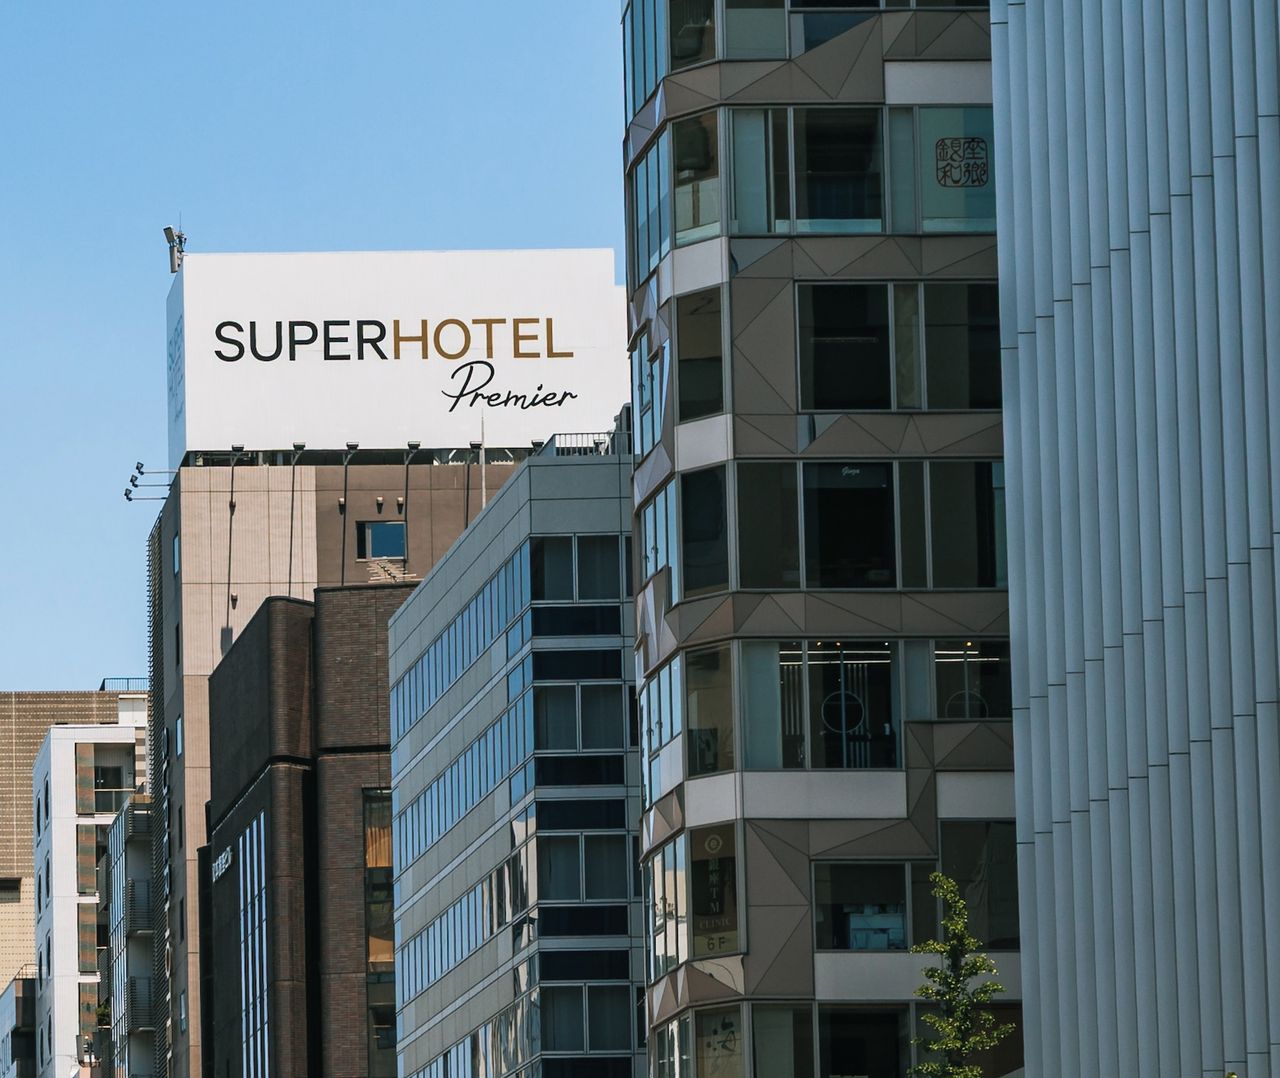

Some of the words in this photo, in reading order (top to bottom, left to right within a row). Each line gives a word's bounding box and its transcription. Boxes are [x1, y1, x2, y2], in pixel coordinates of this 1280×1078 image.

[214, 318, 574, 362] SUPERHOTEL
[441, 360, 578, 413] Premier
[707, 936, 726, 951] 6F
